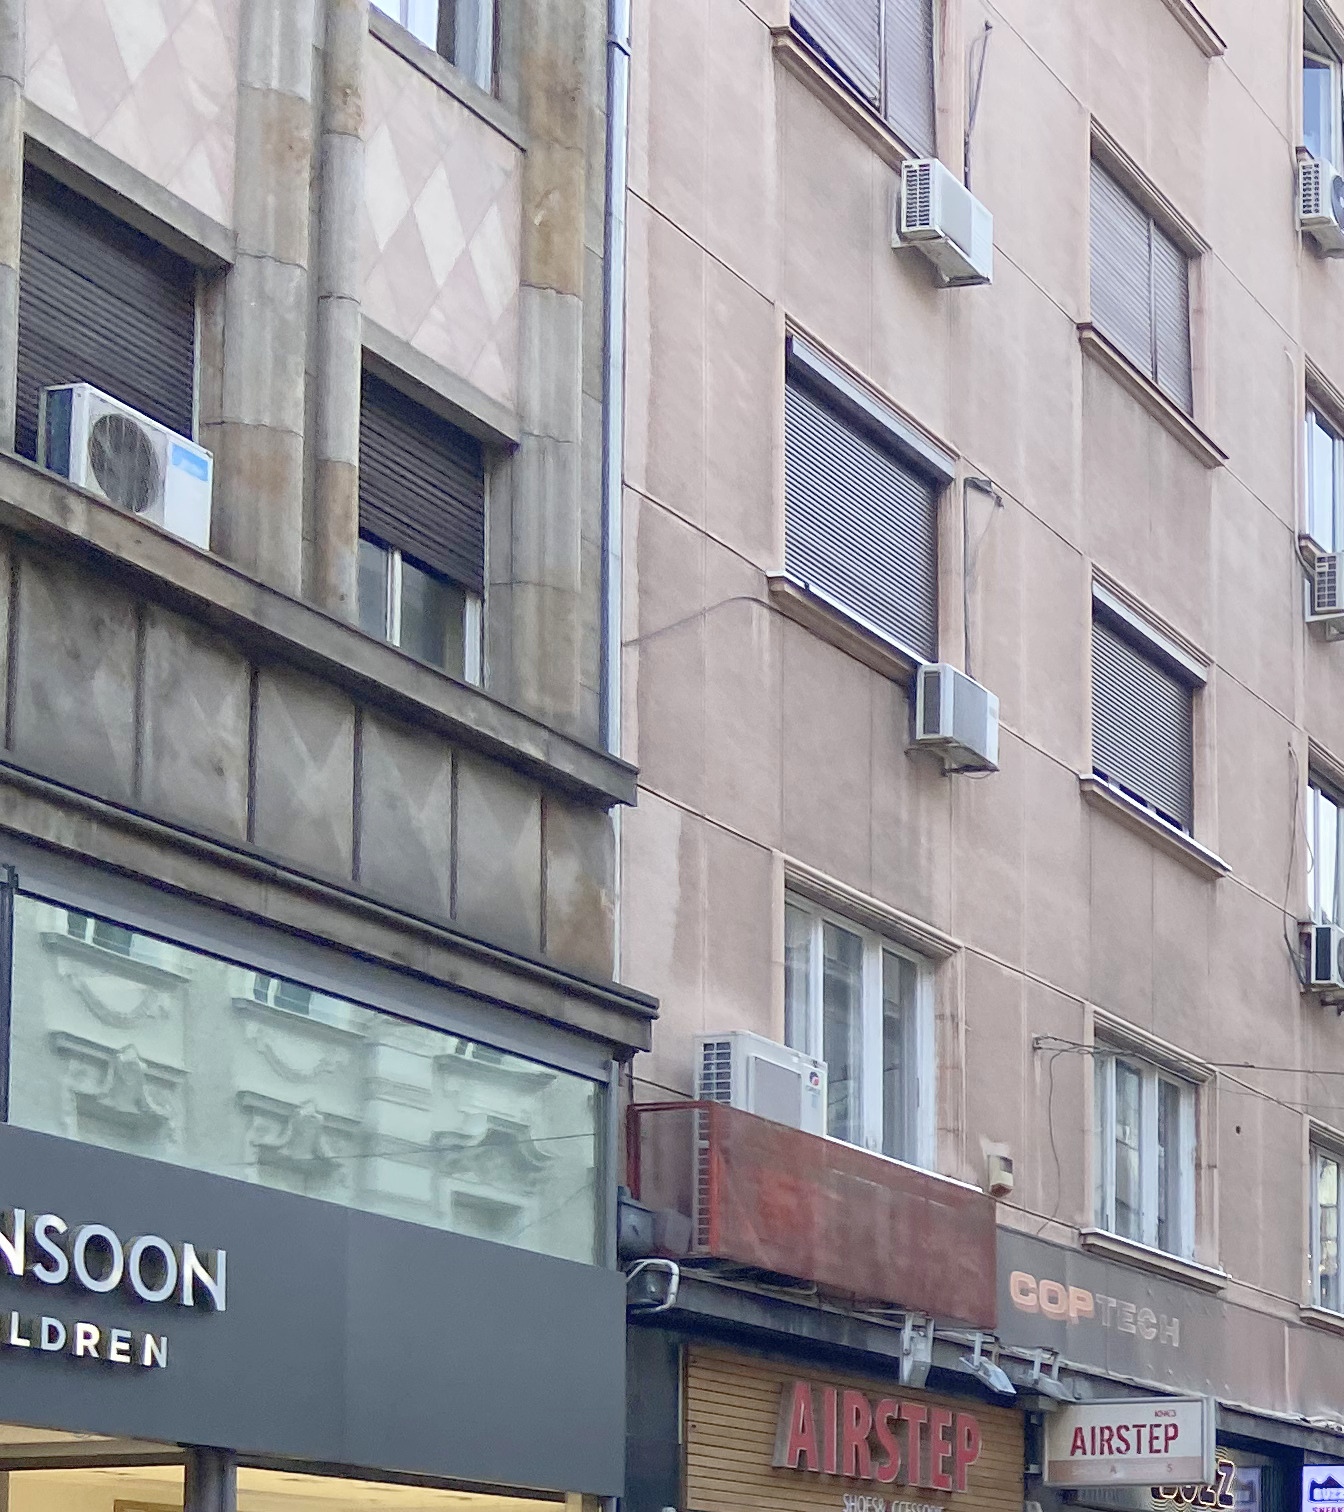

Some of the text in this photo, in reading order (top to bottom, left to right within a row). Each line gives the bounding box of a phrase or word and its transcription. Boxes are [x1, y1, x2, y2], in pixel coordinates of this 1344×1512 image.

[1009, 1270, 1181, 1348] COPTECH
[785, 1380, 984, 1494] AIRSTEP
[1069, 1422, 1179, 1457] AIRSTEP
